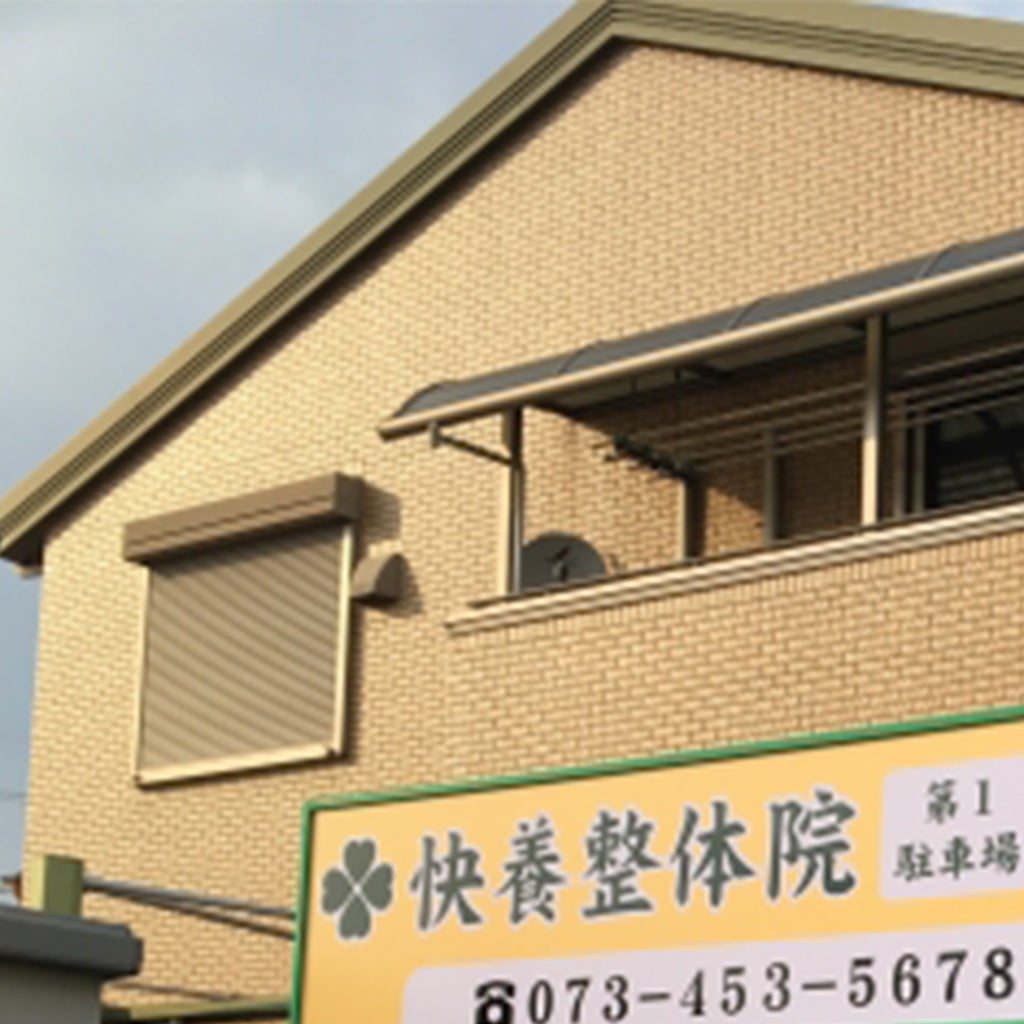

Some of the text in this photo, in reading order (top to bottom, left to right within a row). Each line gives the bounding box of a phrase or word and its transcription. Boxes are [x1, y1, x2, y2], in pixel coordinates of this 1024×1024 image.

[408, 788, 858, 931] 快養整体院
[893, 831, 1021, 883] 駐車場
